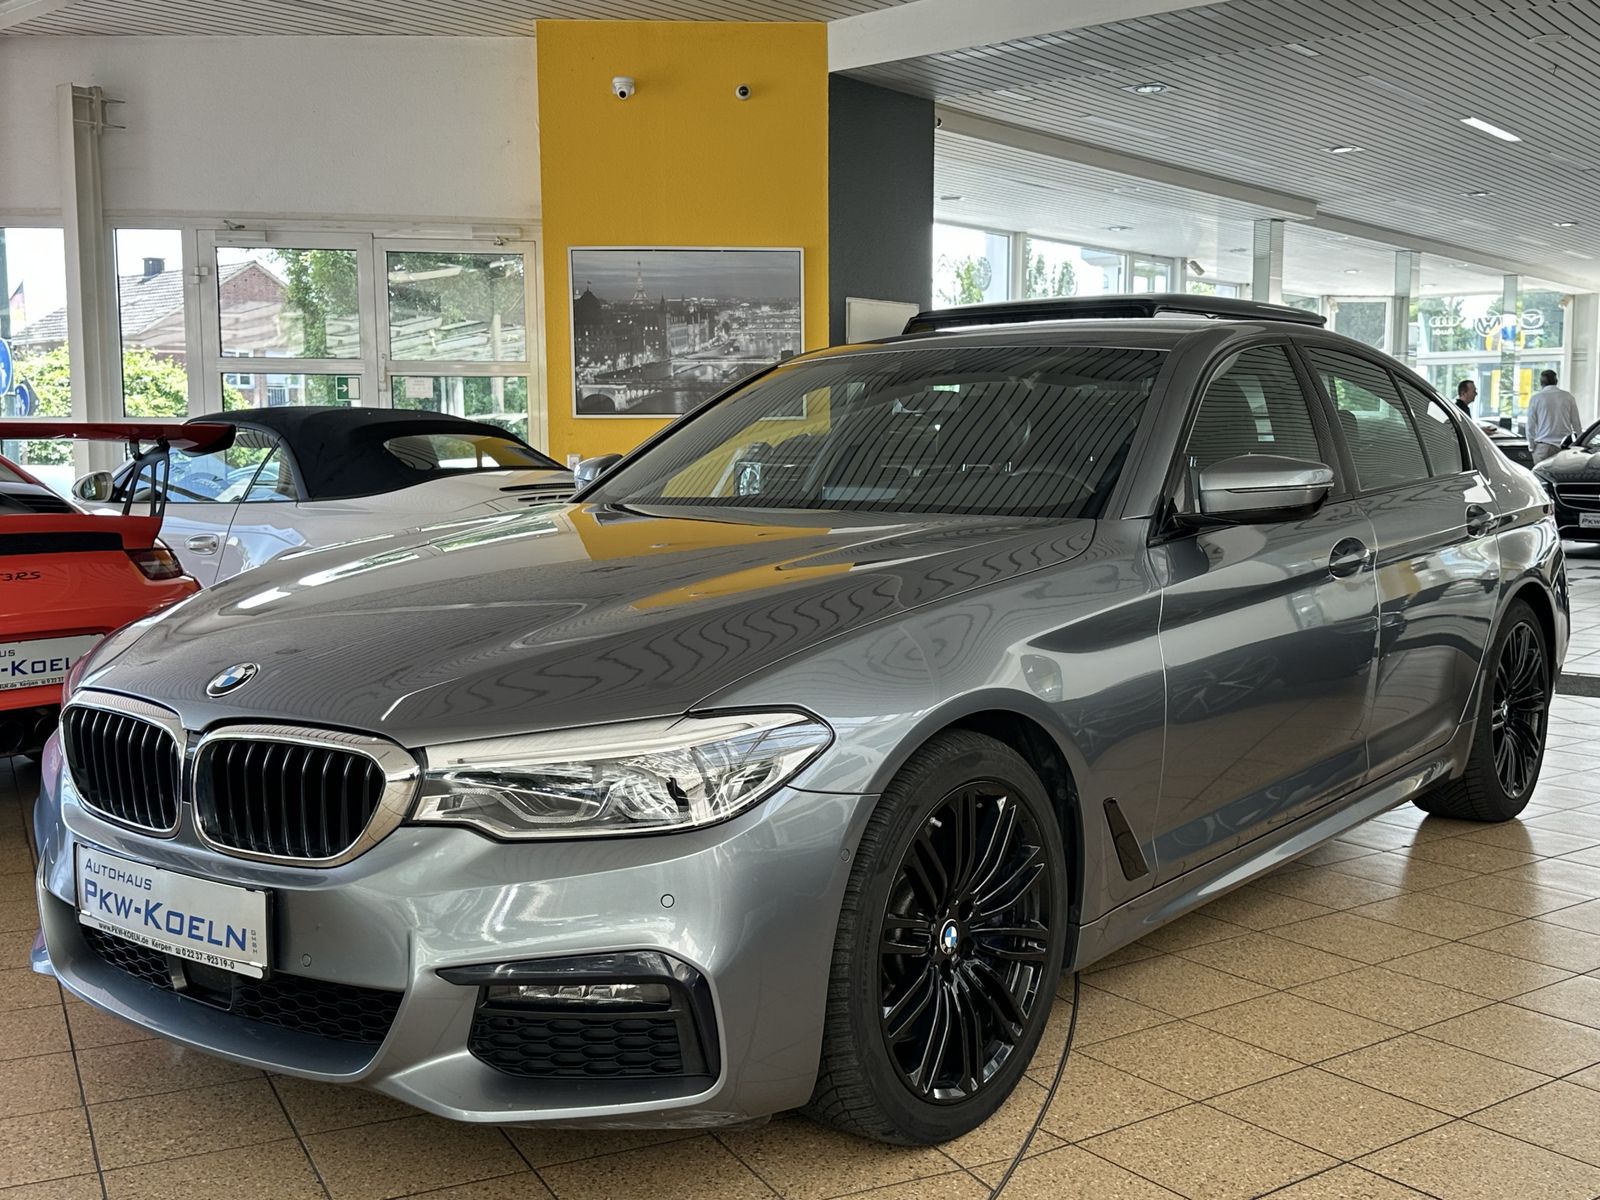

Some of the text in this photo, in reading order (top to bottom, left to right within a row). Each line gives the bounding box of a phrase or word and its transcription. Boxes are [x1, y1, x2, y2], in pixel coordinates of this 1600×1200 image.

[85, 857, 153, 891] AUTOHAUS
[85, 879, 247, 951] PKW-KOELN
[151, 939, 173, 952] Kerpen
